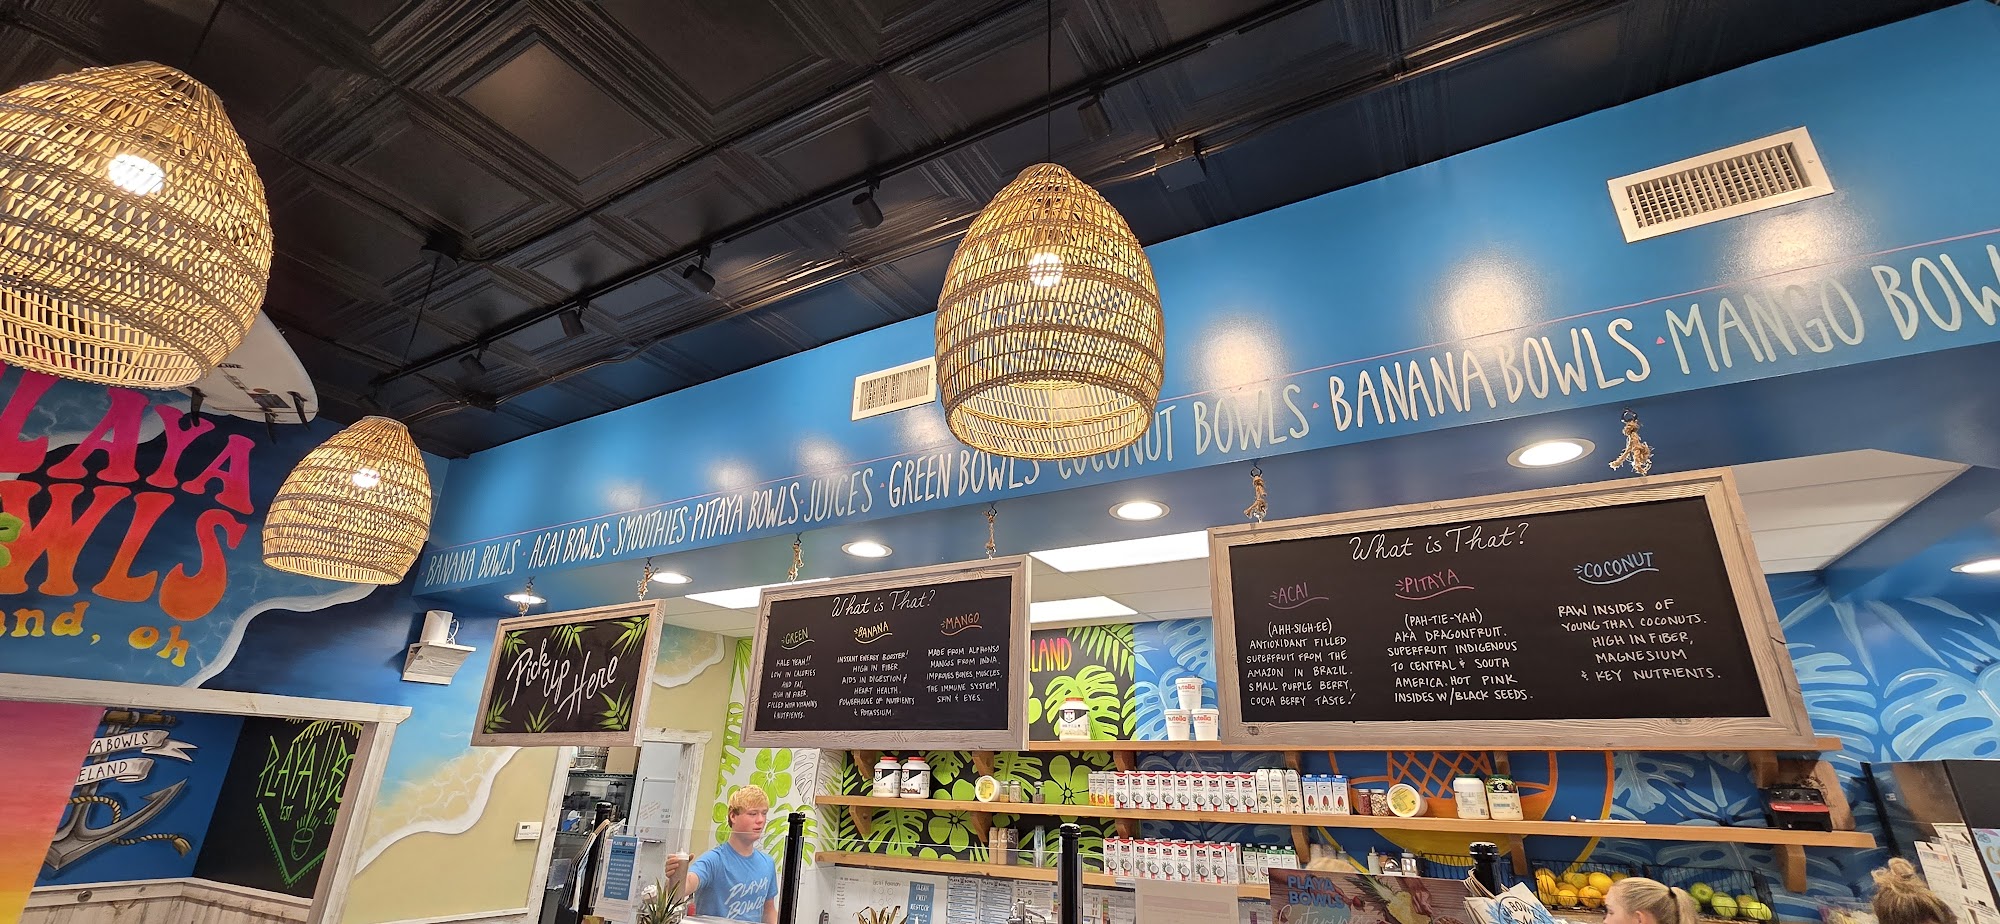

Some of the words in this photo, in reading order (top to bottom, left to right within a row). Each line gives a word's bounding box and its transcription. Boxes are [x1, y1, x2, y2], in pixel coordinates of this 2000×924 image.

[0, 363, 256, 514] LAYA
[425, 551, 475, 587] BANANA
[478, 540, 521, 576] BOWLS
[528, 528, 564, 568] ACAI
[563, 521, 611, 564] BOWLS
[612, 506, 690, 554] SMOOTHIES
[690, 493, 745, 542] PITAYA
[747, 481, 801, 530] BOWLS
[803, 467, 875, 523] JUICES
[888, 452, 953, 506] GREEN
[1194, 383, 1310, 456] BOWLS
[1328, 348, 1496, 431] BANANA
[1496, 318, 1652, 403] BOWLS
[1665, 275, 1866, 375] MANGO
[1349, 533, 1413, 561] What
[1425, 535, 1442, 553] is
[1445, 522, 1530, 553] That?
[1583, 551, 1654, 578] COCONUT
[1404, 569, 1460, 593] PITAYA
[1277, 582, 1309, 603] ACAI
[831, 594, 870, 617] What
[874, 597, 884, 612] is
[889, 589, 936, 610] That?
[1558, 604, 1589, 617] RAW
[1592, 602, 1646, 615] INSIDES
[1655, 598, 1675, 611] OF
[944, 612, 980, 630] MANGO
[1268, 617, 1333, 637] (AHH-SIGH-EE)
[1404, 607, 1483, 632] (PAH-TIE-YAH)
[1561, 620, 1600, 633] YOUNG
[1602, 617, 1635, 631] THAI
[1639, 614, 1708, 627] COCONUTS.
[0, 601, 100, 646] nd,
[128, 625, 191, 667] oh
[785, 627, 809, 645] GREEN
[857, 621, 889, 639] BANANA
[1394, 630, 1417, 643] AKA
[1425, 627, 1508, 642] DRAGONFRUIT.
[1250, 638, 1307, 650] ANTIOXIDANT
[1314, 636, 1347, 647] FILLED
[1387, 644, 1448, 657] SUPERFRUIT
[1455, 640, 1518, 654] INDIGENOUS
[1591, 633, 1626, 648] HIGH
[1628, 633, 1645, 645] IN
[1648, 631, 1695, 646] FIBER,
[837, 654, 858, 663] INSTANT
[928, 648, 945, 657] MADE
[947, 647, 964, 656] FROM
[1030, 637, 1073, 673] LAND
[1246, 653, 1295, 664] SUPERFRUIT
[1298, 652, 1323, 662] FROM
[1328, 650, 1348, 661] THE
[1595, 649, 1688, 664] MAGNESIUM
[852, 664, 868, 673] HIGH
[871, 663, 877, 671] IN
[930, 659, 954, 668] MANGOS
[957, 658, 975, 666] FROM
[1247, 667, 1284, 678] AMAZON
[1294, 667, 1303, 677] IN
[1313, 665, 1353, 676] BRAZIL.
[1391, 662, 1404, 671] TO
[1409, 659, 1457, 671] CENTRAL
[1474, 657, 1510, 669] SOUTH
[507, 638, 551, 706] Pick
[557, 651, 618, 721] Here
[841, 676, 856, 684] AIDS
[859, 676, 866, 684] IN
[869, 674, 902, 683] DIGESTION
[1395, 676, 1448, 689] AMERICA.
[1450, 676, 1471, 686] HOT
[1482, 673, 1518, 685] PINK
[1595, 670, 1623, 683] KEY
[1634, 666, 1722, 680] NUTRIENTS.
[854, 686, 873, 695] HEART
[926, 685, 938, 693] THE
[941, 684, 966, 692] IMMUNE
[1248, 682, 1278, 692] SMALL
[1282, 681, 1313, 692] PURPLE
[838, 697, 873, 706] POWERHOUSE
[1250, 696, 1276, 706] COCOA
[1280, 695, 1306, 706] BERRY
[1314, 692, 1356, 706] TASTE!
[1395, 692, 1434, 703] INSIDES
[1494, 690, 1534, 701] SEEDS.
[107, 732, 149, 752] BOWLS
[256, 735, 318, 809] PLAYA
[325, 807, 339, 825] 20
[724, 877, 769, 905] PLAYA
[1287, 874, 1336, 893] PLAYA
[1288, 890, 1345, 909] BOWLS
